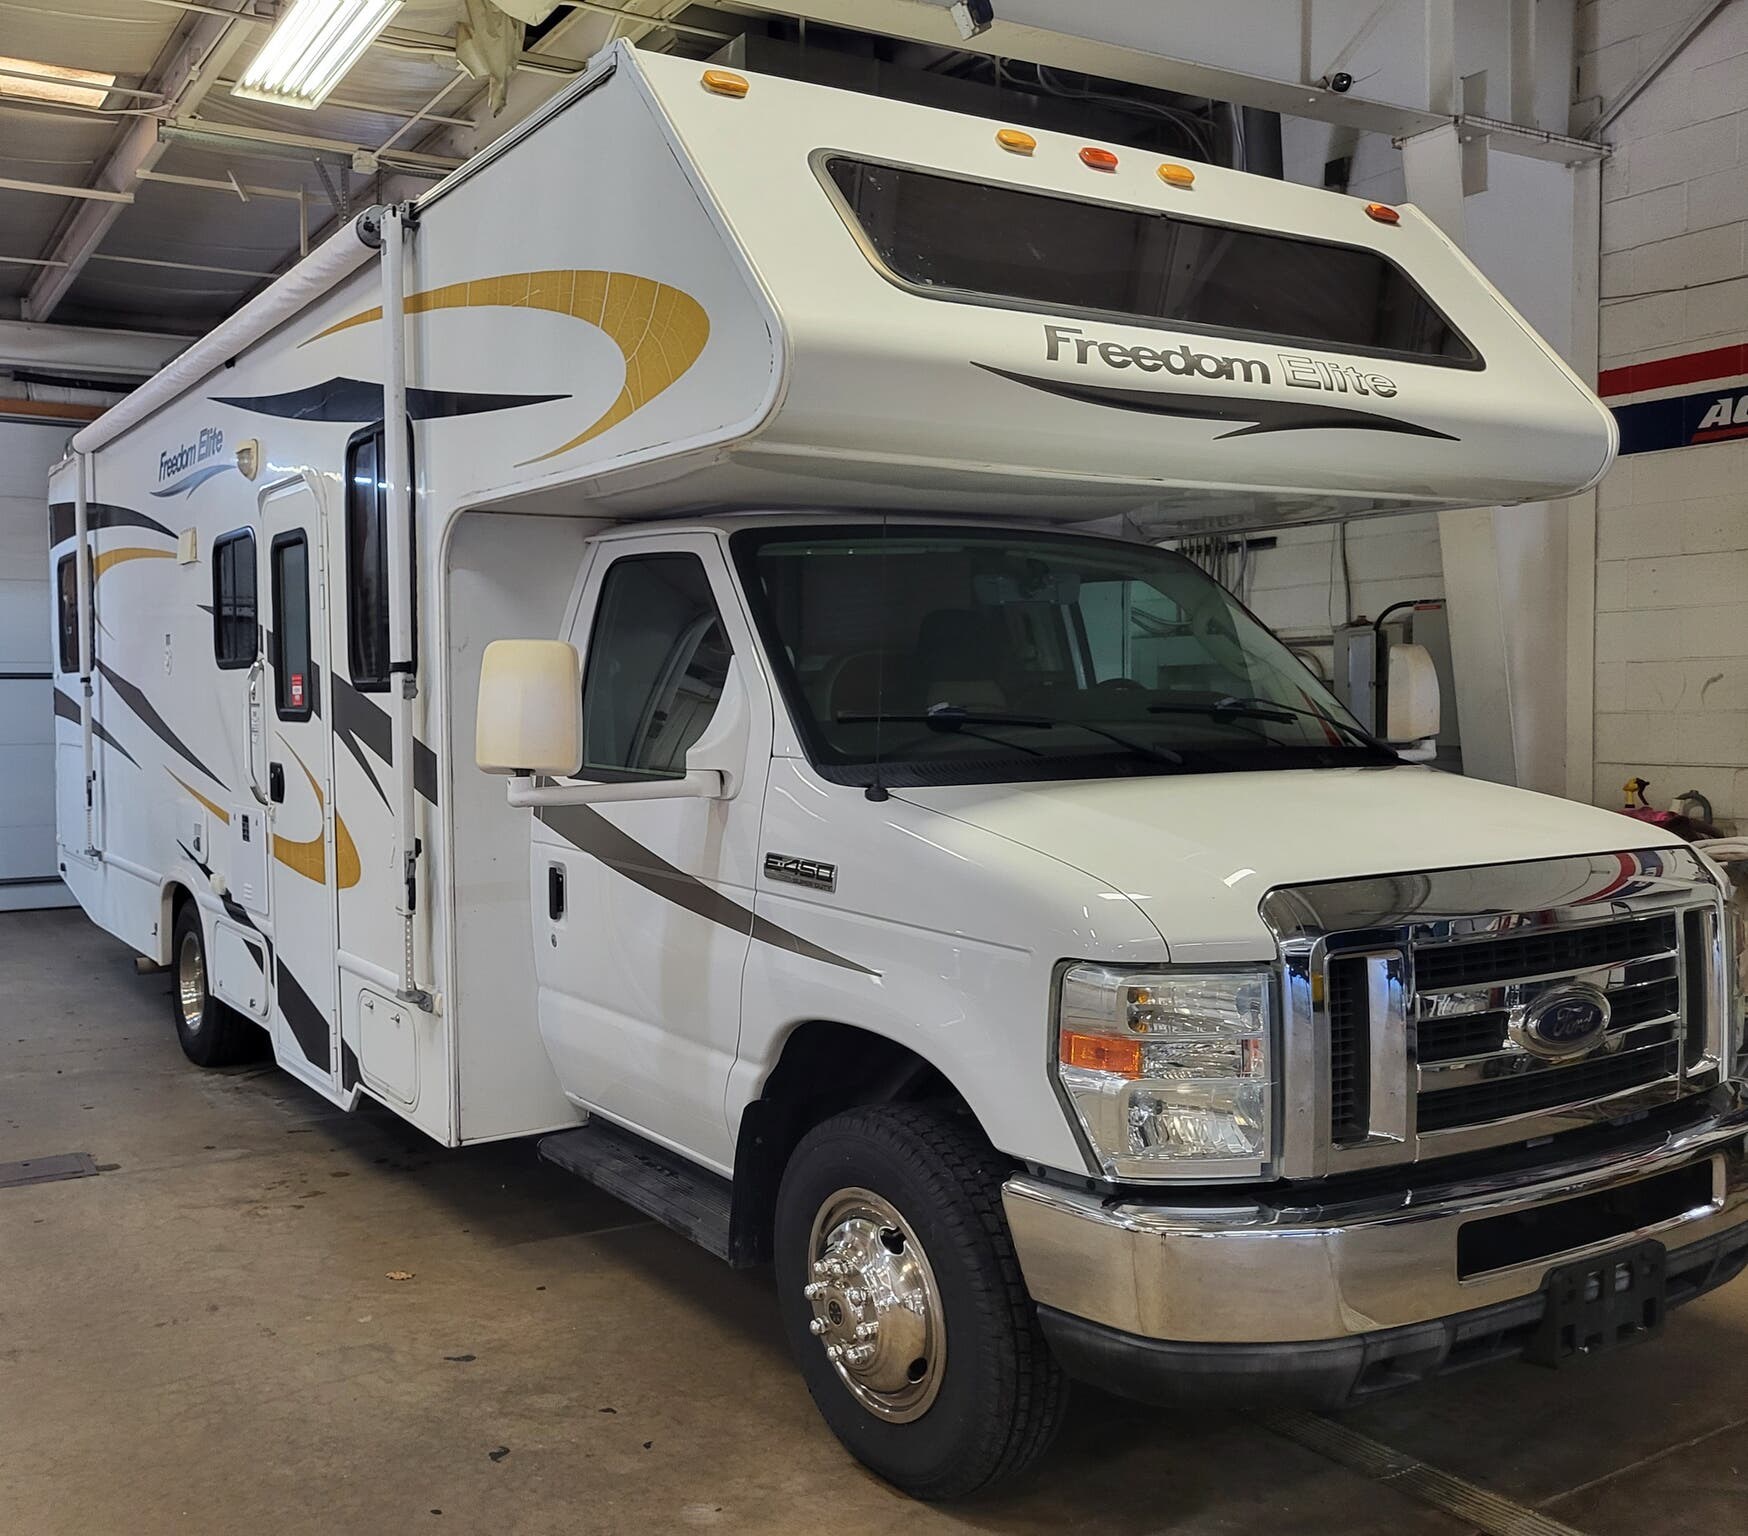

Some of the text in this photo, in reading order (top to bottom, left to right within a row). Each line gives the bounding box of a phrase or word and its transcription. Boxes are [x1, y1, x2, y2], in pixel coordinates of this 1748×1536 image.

[1044, 324, 1398, 399] Freedom Elite
[158, 427, 224, 482] Freedom Elite
[1553, 1006, 1594, 1037] Ford
